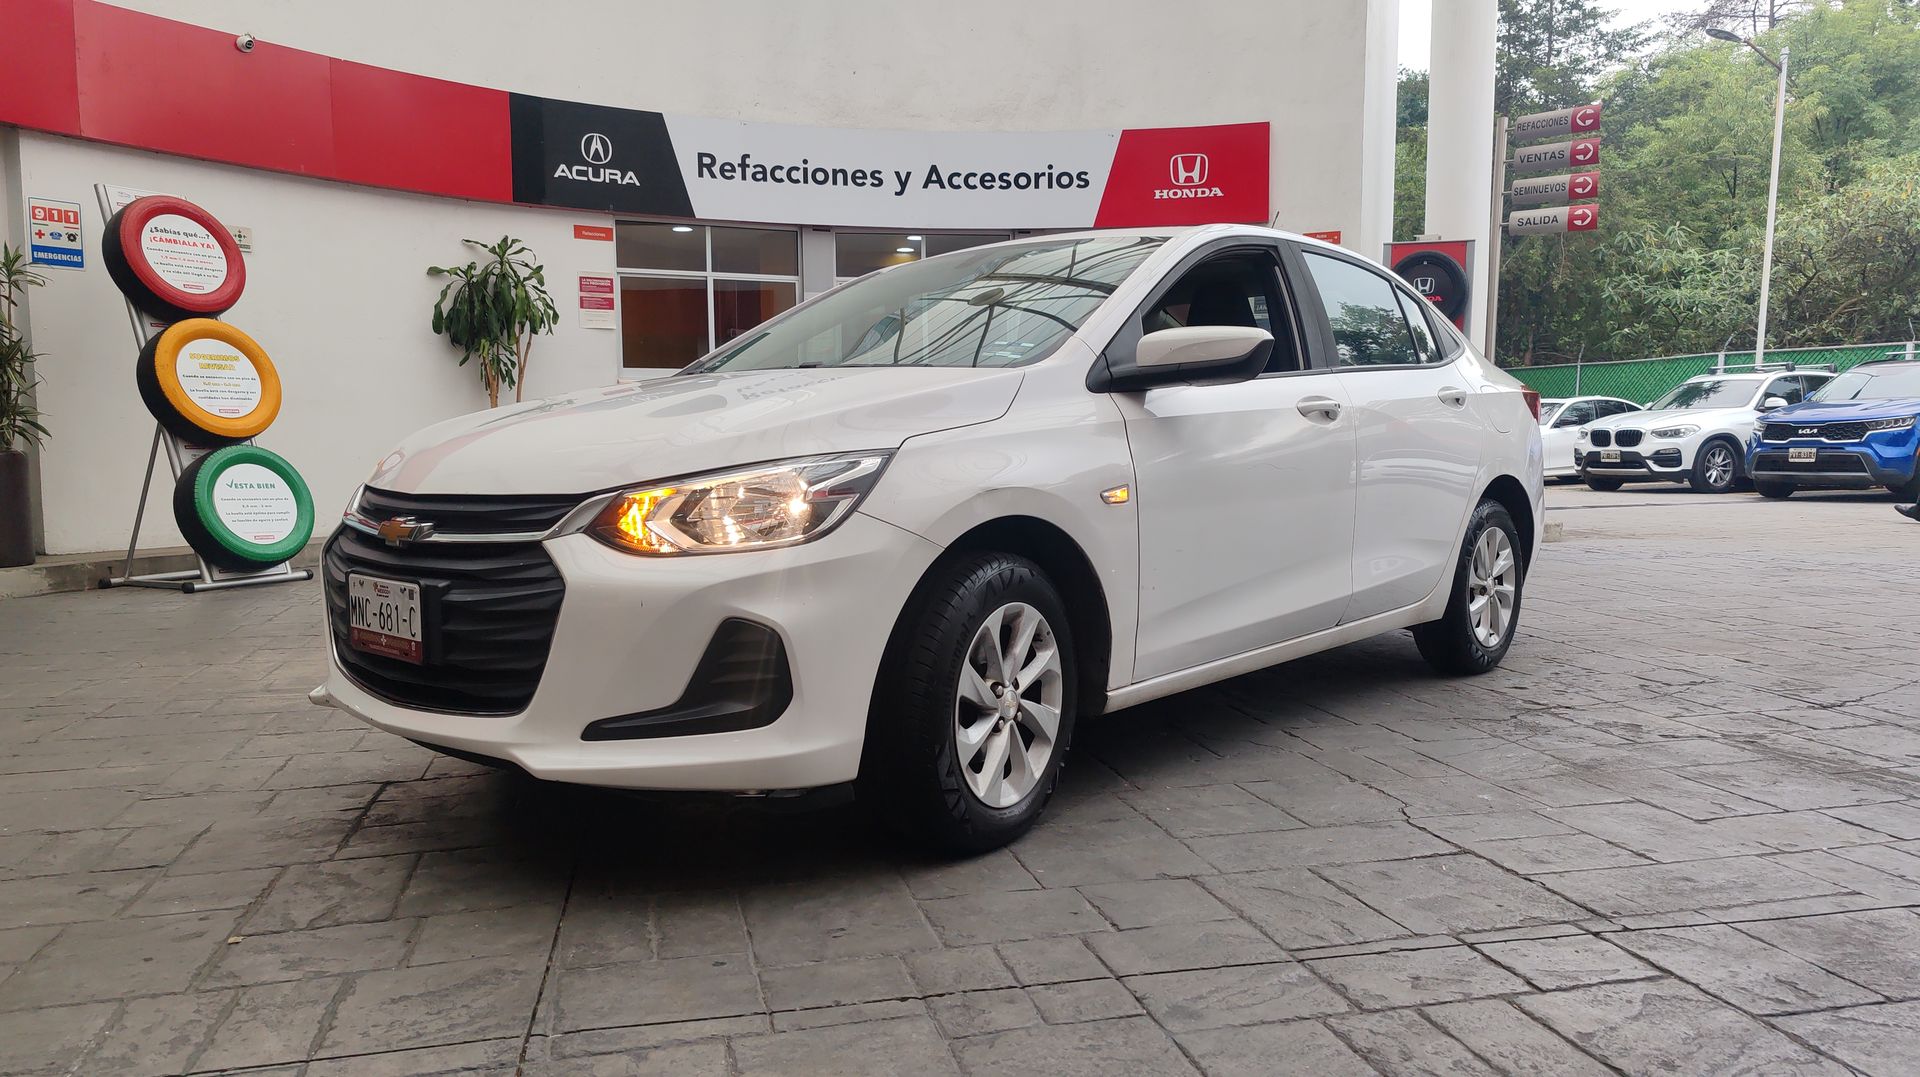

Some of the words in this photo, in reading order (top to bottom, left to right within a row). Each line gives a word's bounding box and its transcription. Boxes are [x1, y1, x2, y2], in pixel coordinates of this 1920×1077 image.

[1517, 116, 1569, 132] REFACCIONES
[1520, 150, 1565, 163] VENTAS
[553, 163, 641, 186] ACURA
[697, 151, 883, 188] Refacciones
[894, 168, 911, 196] y
[922, 163, 1090, 191] Accesorios
[1154, 187, 1224, 199] HONDA
[1514, 183, 1566, 196] SEMINUEVOS
[34, 208, 74, 223] 911
[1517, 215, 1559, 227] SALIDA
[33, 251, 82, 262] EMERGENCIAS
[350, 595, 417, 638] MNC-681-C
